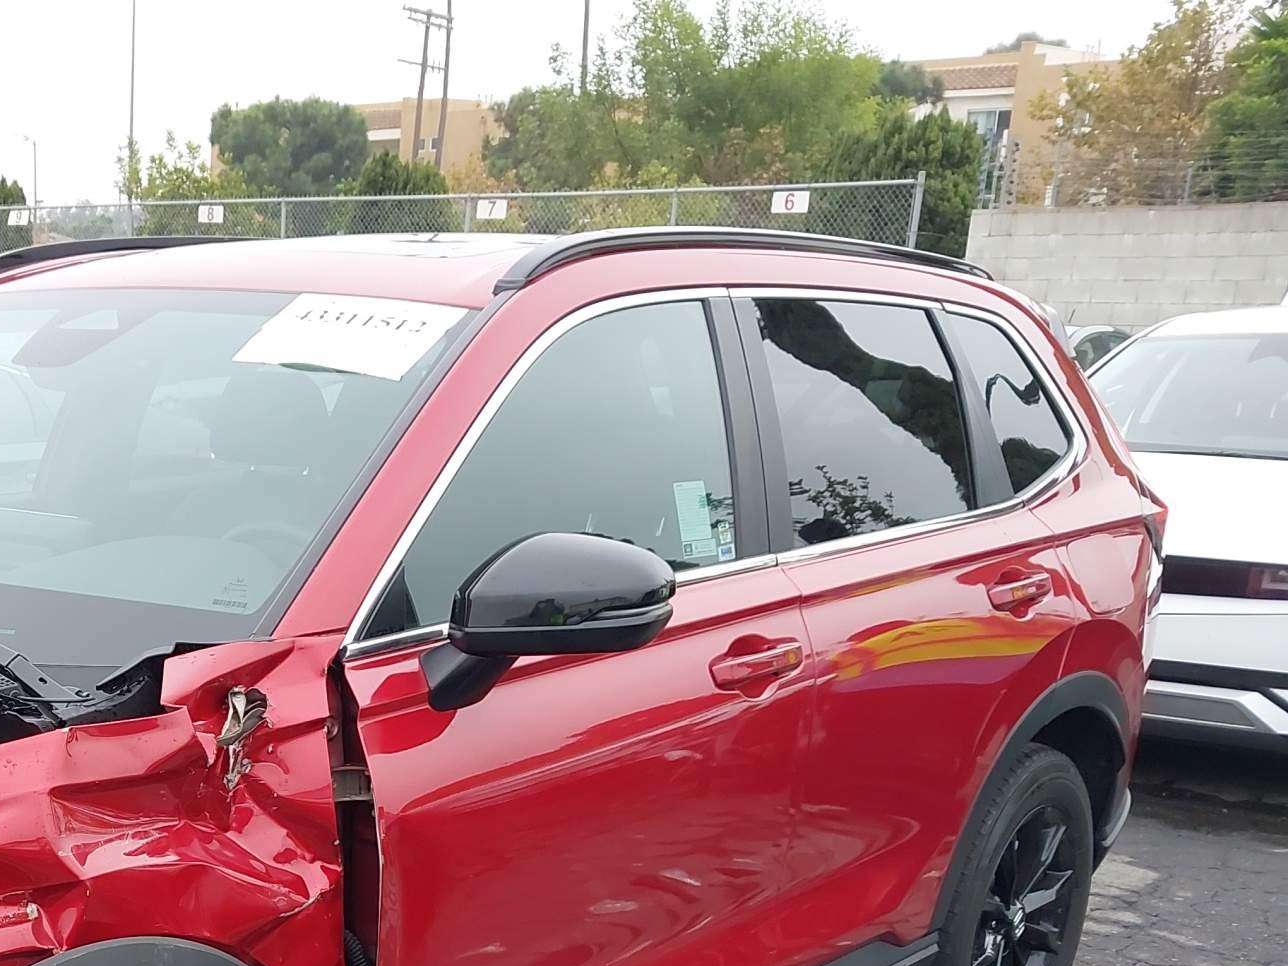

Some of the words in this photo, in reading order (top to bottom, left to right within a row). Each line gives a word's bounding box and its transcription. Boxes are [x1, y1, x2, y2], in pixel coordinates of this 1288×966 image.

[487, 200, 497, 217] 7
[784, 192, 796, 211] 6
[15, 211, 23, 224] 9
[207, 207, 215, 222] 8
